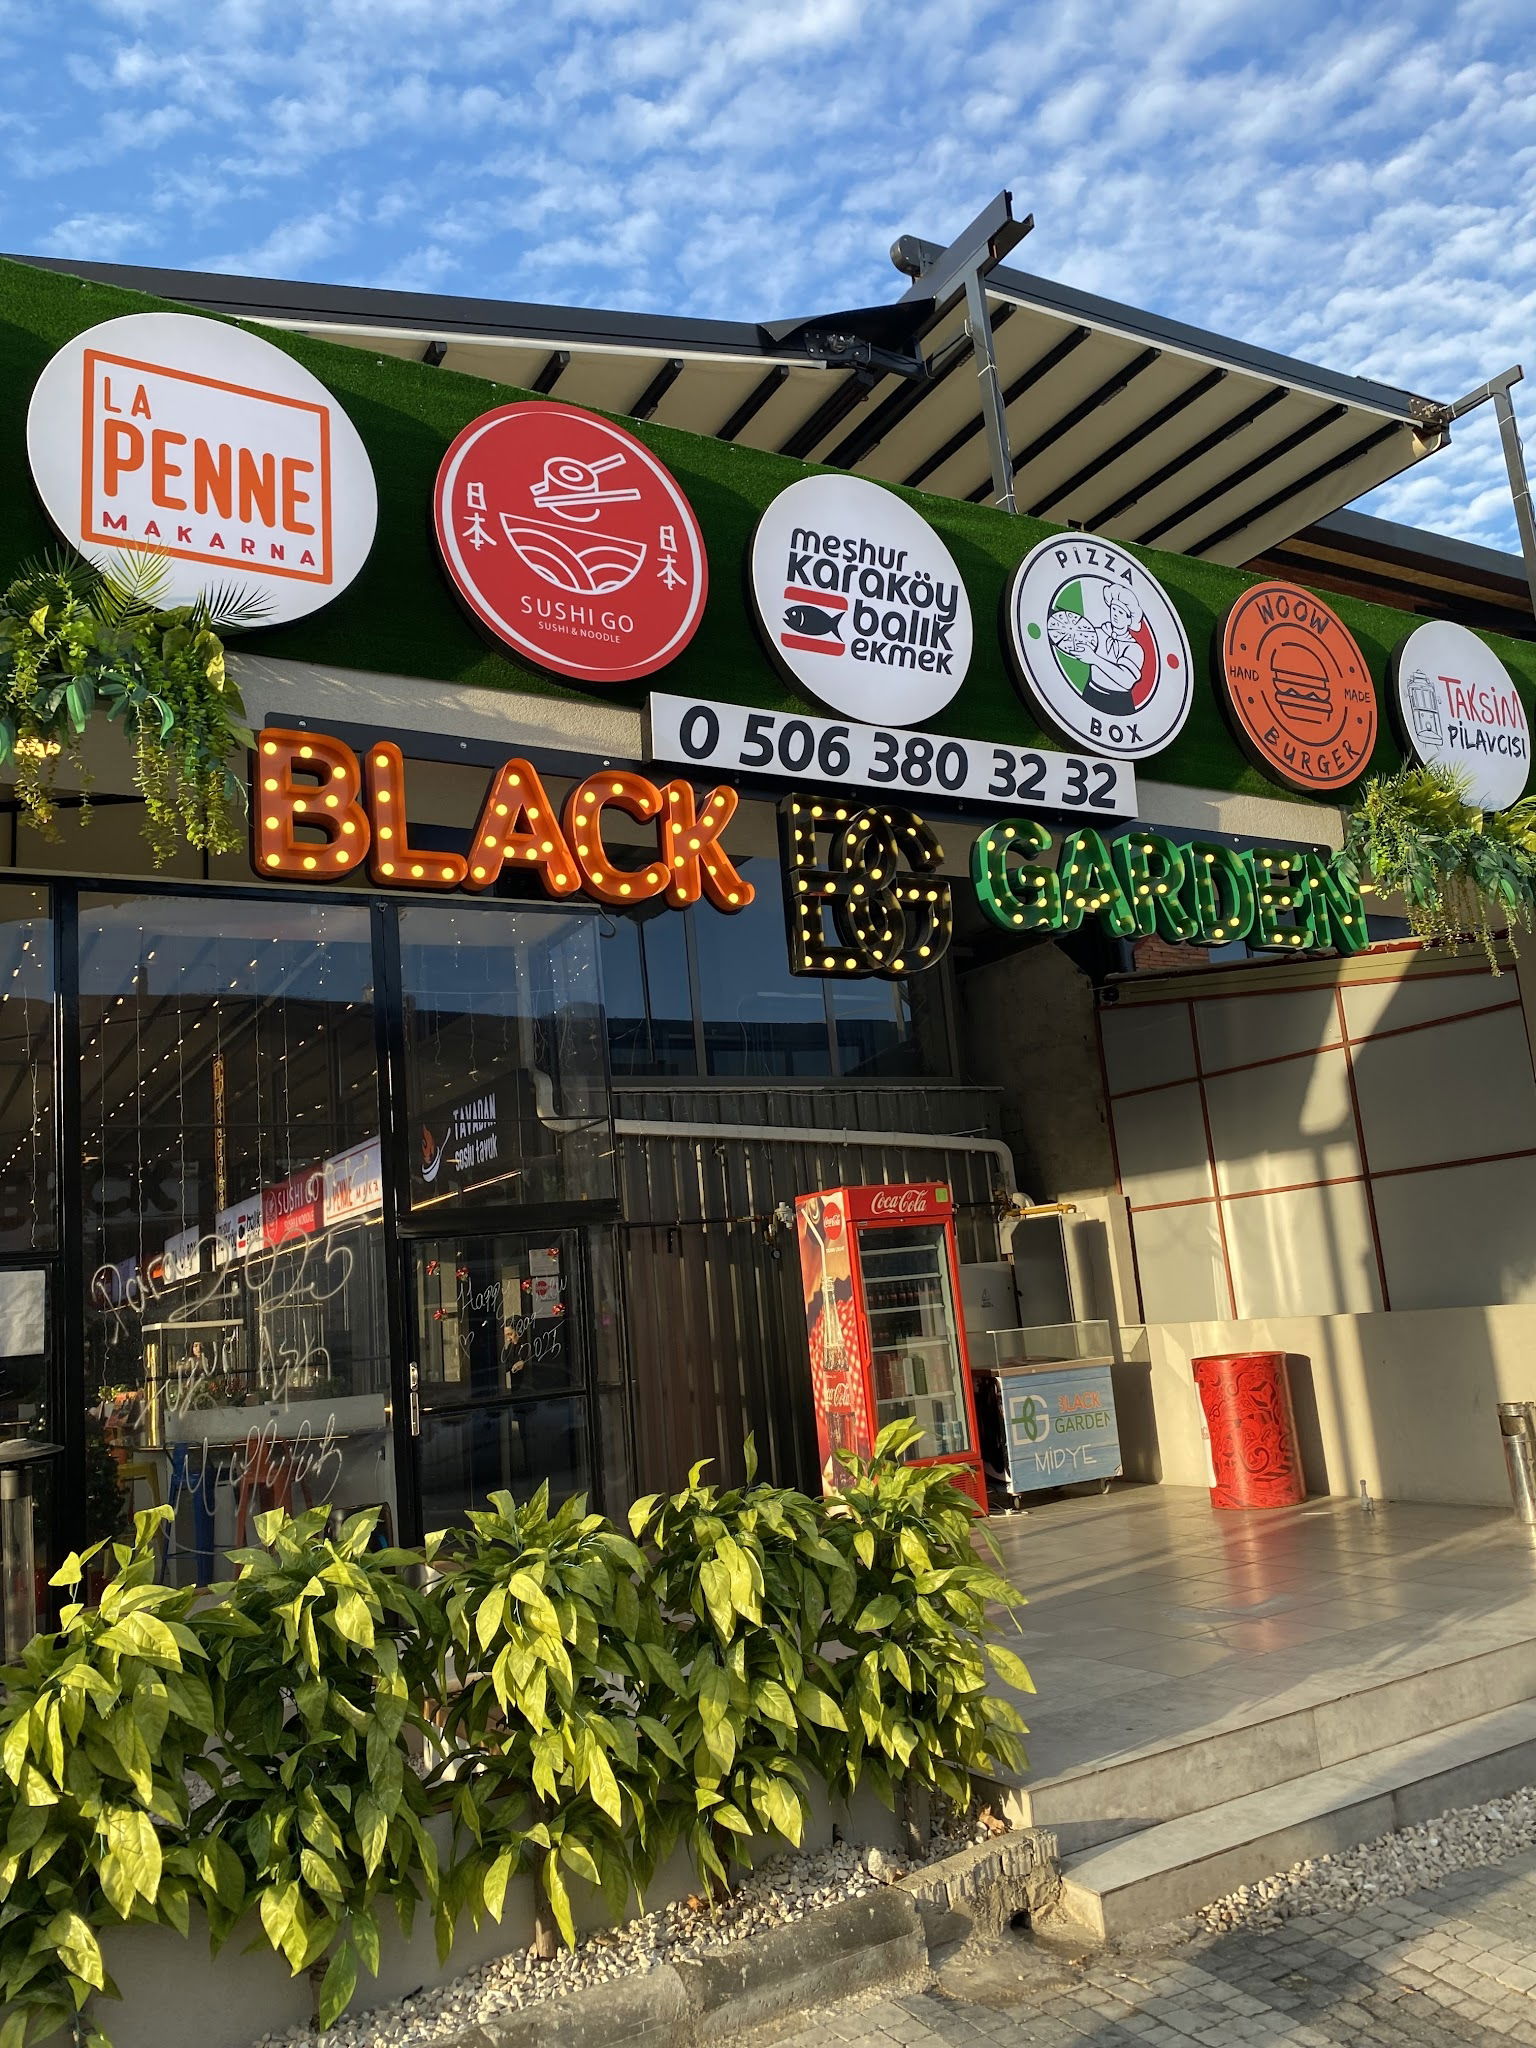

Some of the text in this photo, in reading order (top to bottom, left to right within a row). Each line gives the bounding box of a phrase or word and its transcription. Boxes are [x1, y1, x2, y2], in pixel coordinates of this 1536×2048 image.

[103, 376, 152, 420] LA
[103, 418, 315, 536] PENNE
[102, 511, 316, 567] MAKARNA
[520, 595, 635, 634] SUSHI GO
[538, 620, 570, 634] SUSHI
[580, 628, 621, 644] NOODLE
[1256, 594, 1330, 635] WOOW
[850, 637, 955, 676] ekmek
[1229, 665, 1260, 682] HAND
[1344, 688, 1371, 704] MADE
[1089, 716, 1144, 744] BOX
[678, 705, 1118, 809] 0 506 380 32 32
[1263, 725, 1361, 777] BURGER
[257, 727, 756, 910] BLACK
[970, 818, 1370, 954] GARDEN
[453, 1092, 497, 1140] TAVADAN
[871, 1189, 929, 1215] Coca-Cola
[1058, 1391, 1103, 1413] BLACK
[1055, 1411, 1111, 1434] GARDEN
